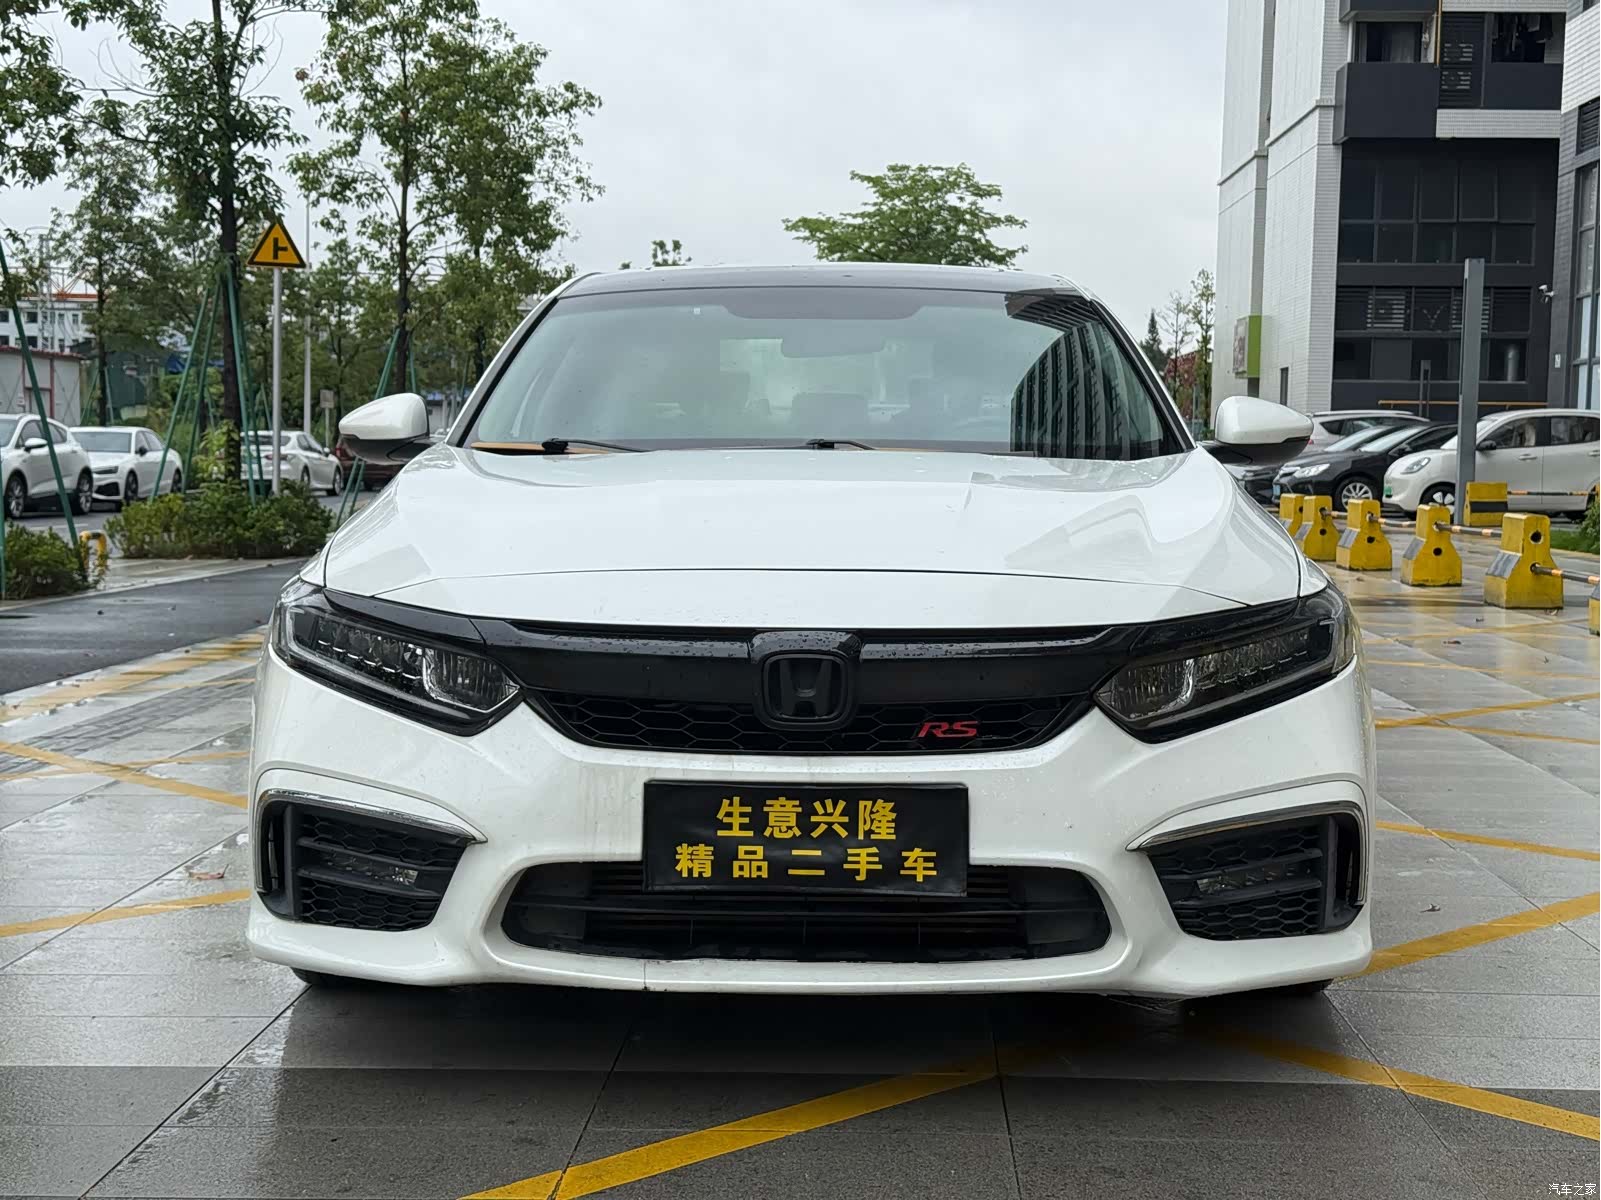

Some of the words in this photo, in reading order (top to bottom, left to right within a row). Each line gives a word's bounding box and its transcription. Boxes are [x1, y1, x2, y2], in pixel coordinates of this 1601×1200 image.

[918, 721, 979, 738] RS
[717, 796, 897, 839] 生意兴隆
[675, 843, 939, 882] 精品二手车
